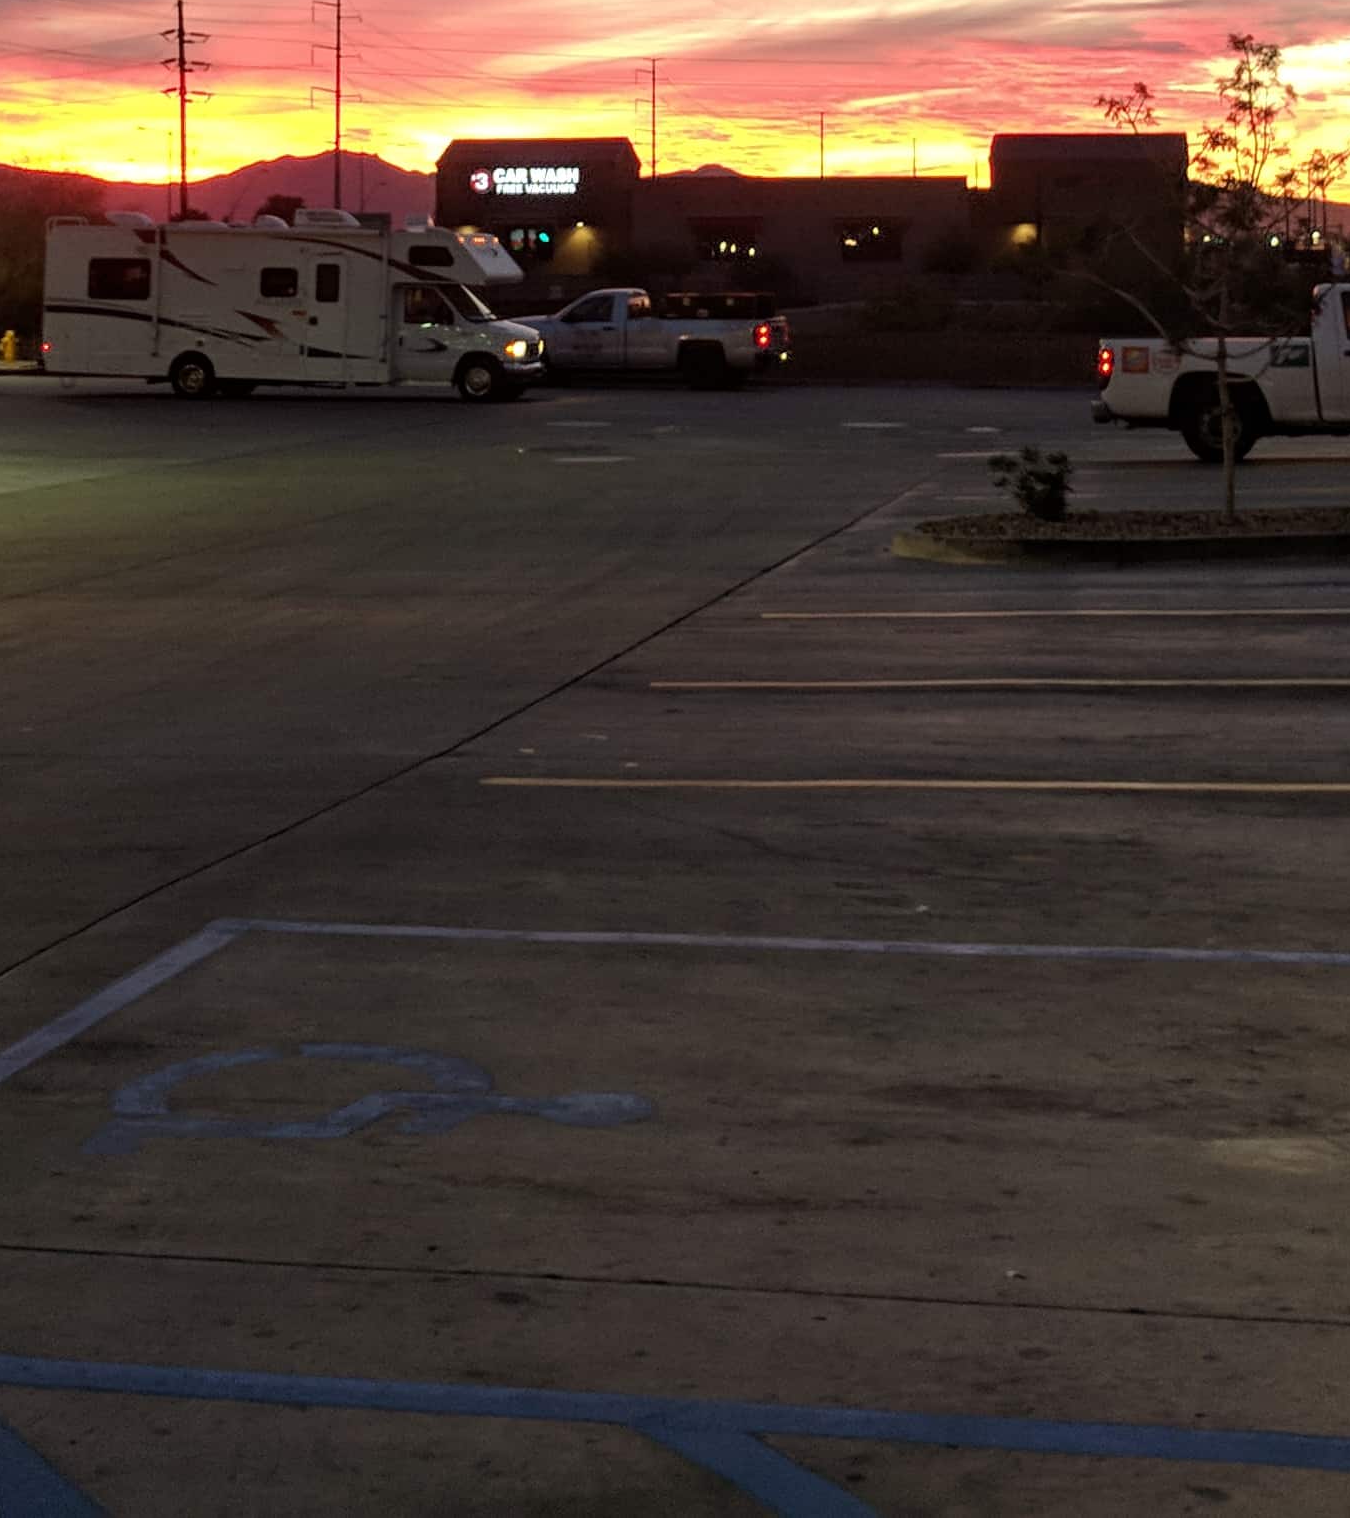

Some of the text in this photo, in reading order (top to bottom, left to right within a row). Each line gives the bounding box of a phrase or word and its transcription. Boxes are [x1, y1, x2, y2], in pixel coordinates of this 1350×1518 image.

[492, 167, 579, 184] CAR WASH
[495, 183, 576, 194] FREE VACUUMS
